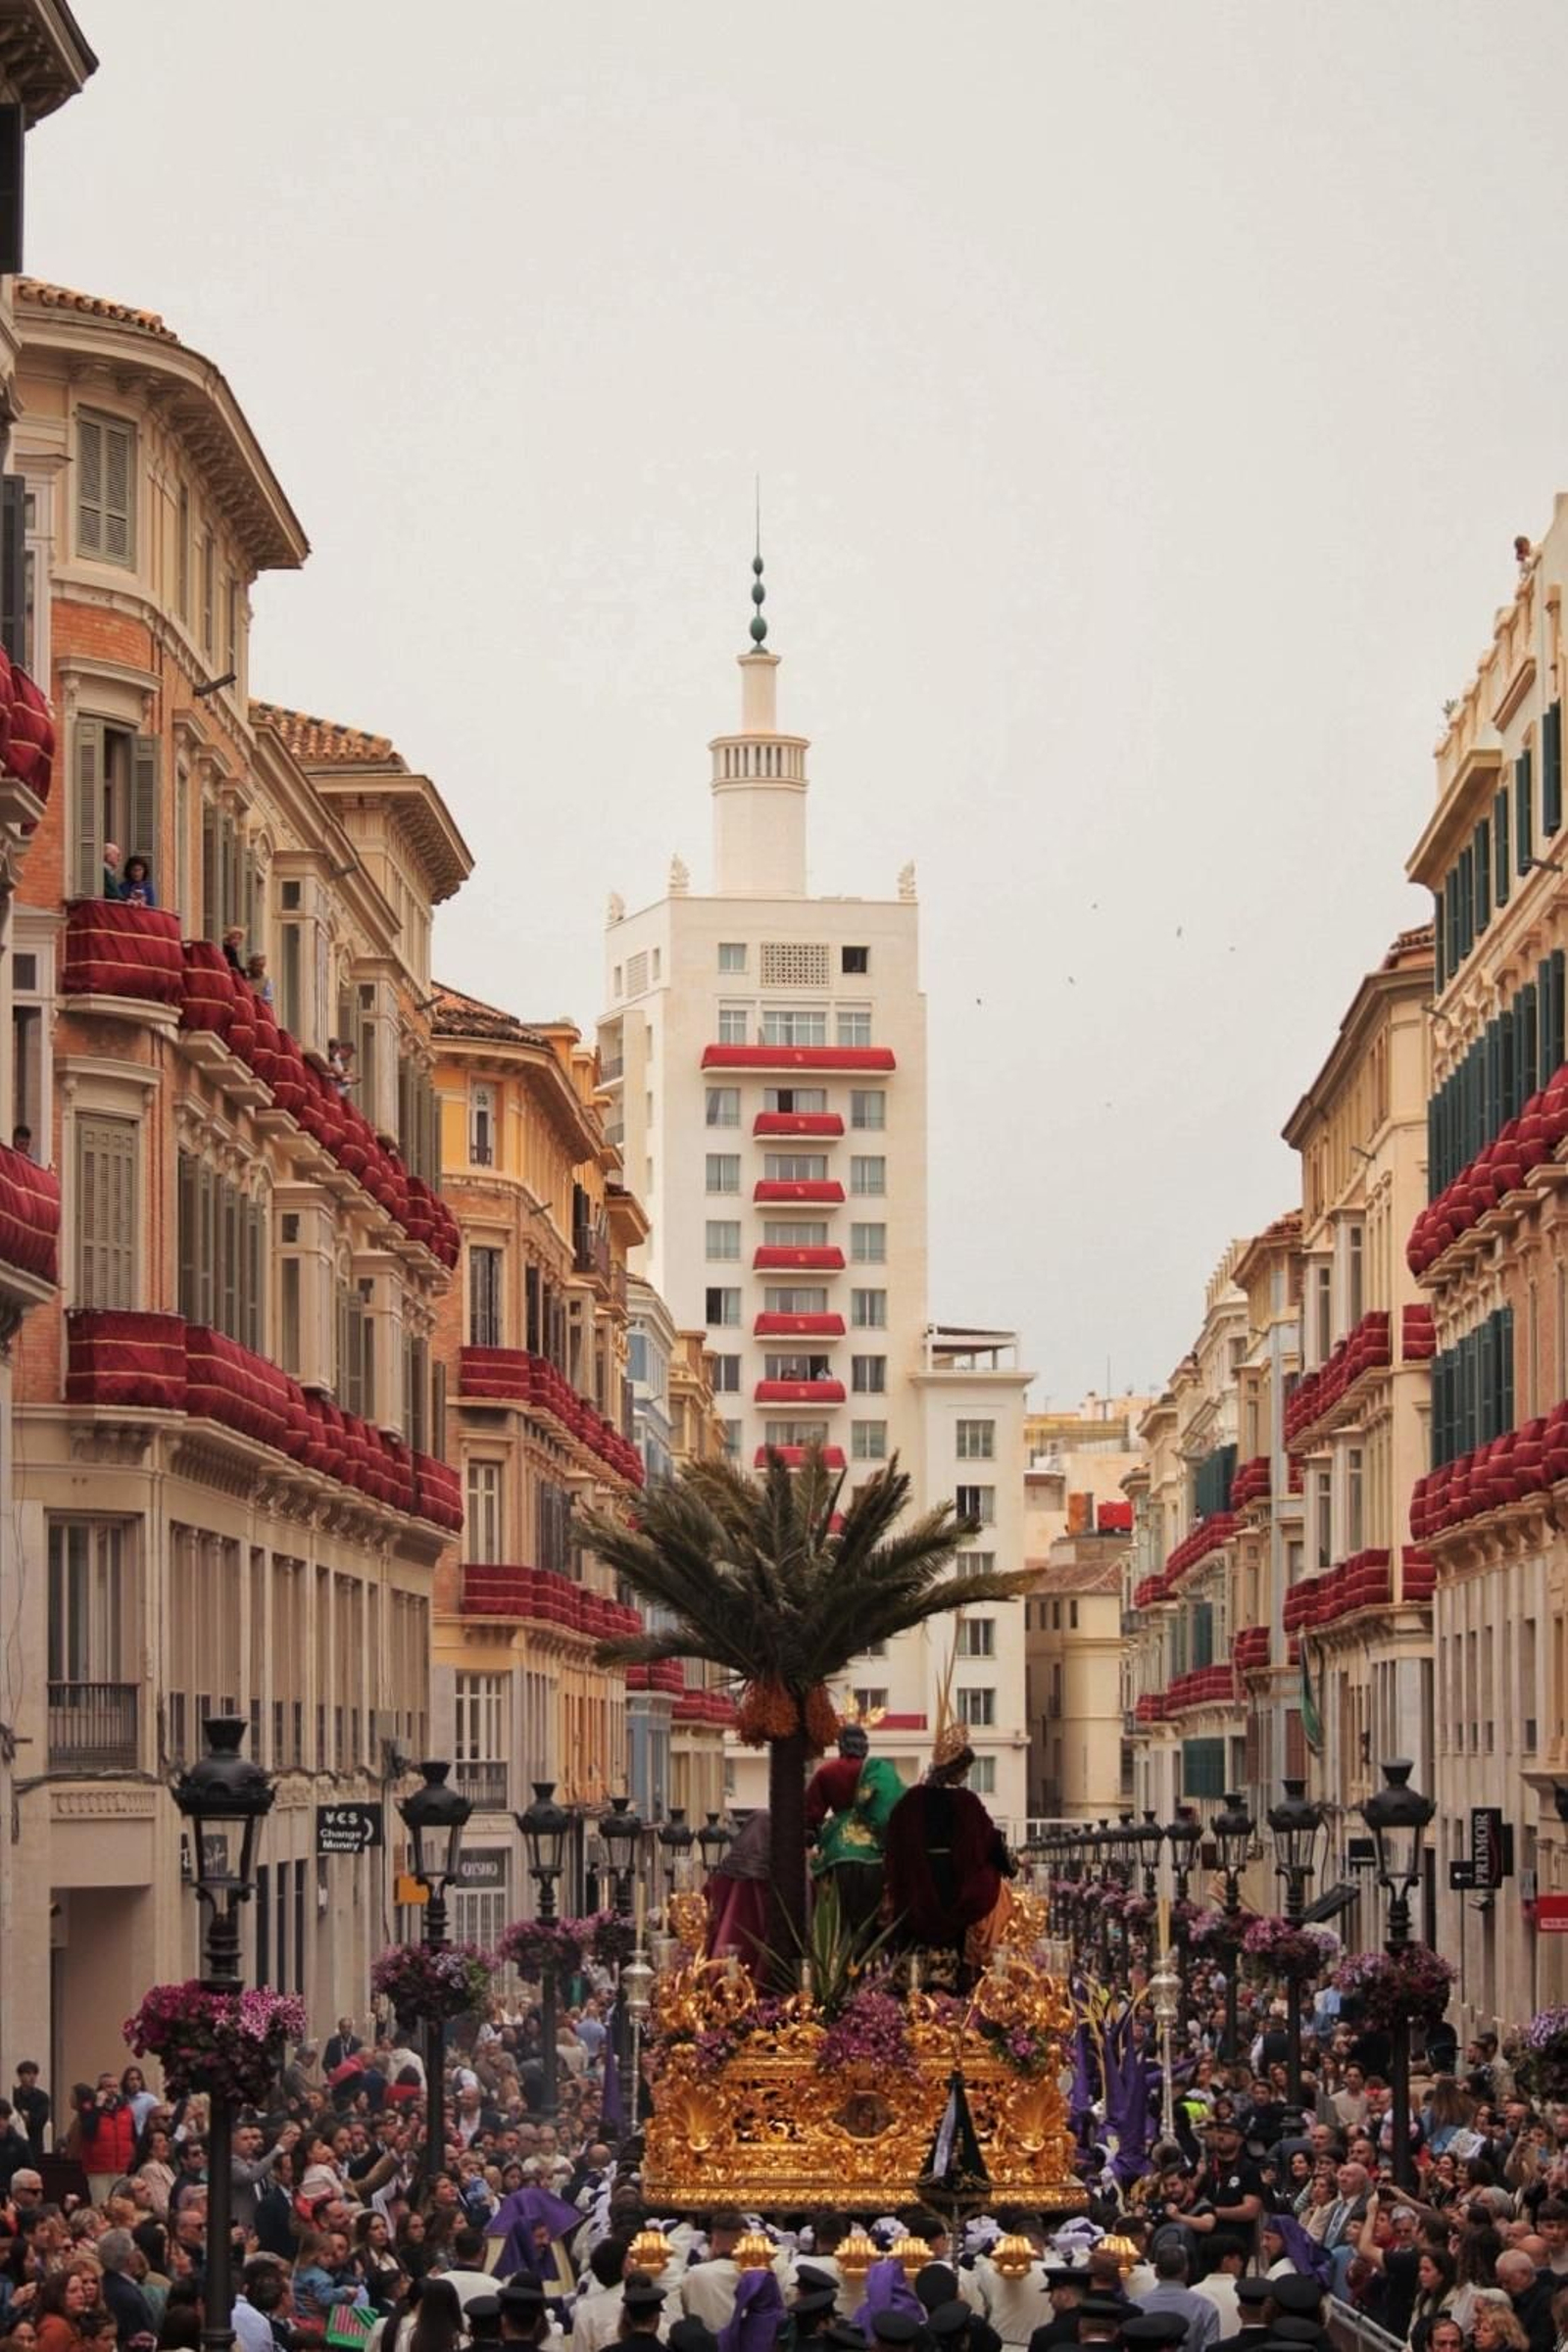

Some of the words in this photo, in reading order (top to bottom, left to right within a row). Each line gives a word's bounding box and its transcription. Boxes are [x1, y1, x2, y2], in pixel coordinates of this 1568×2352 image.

[319, 1828, 363, 1841] Change
[322, 1839, 360, 1851] Money
[1474, 1813, 1490, 1885] PRIMOR
